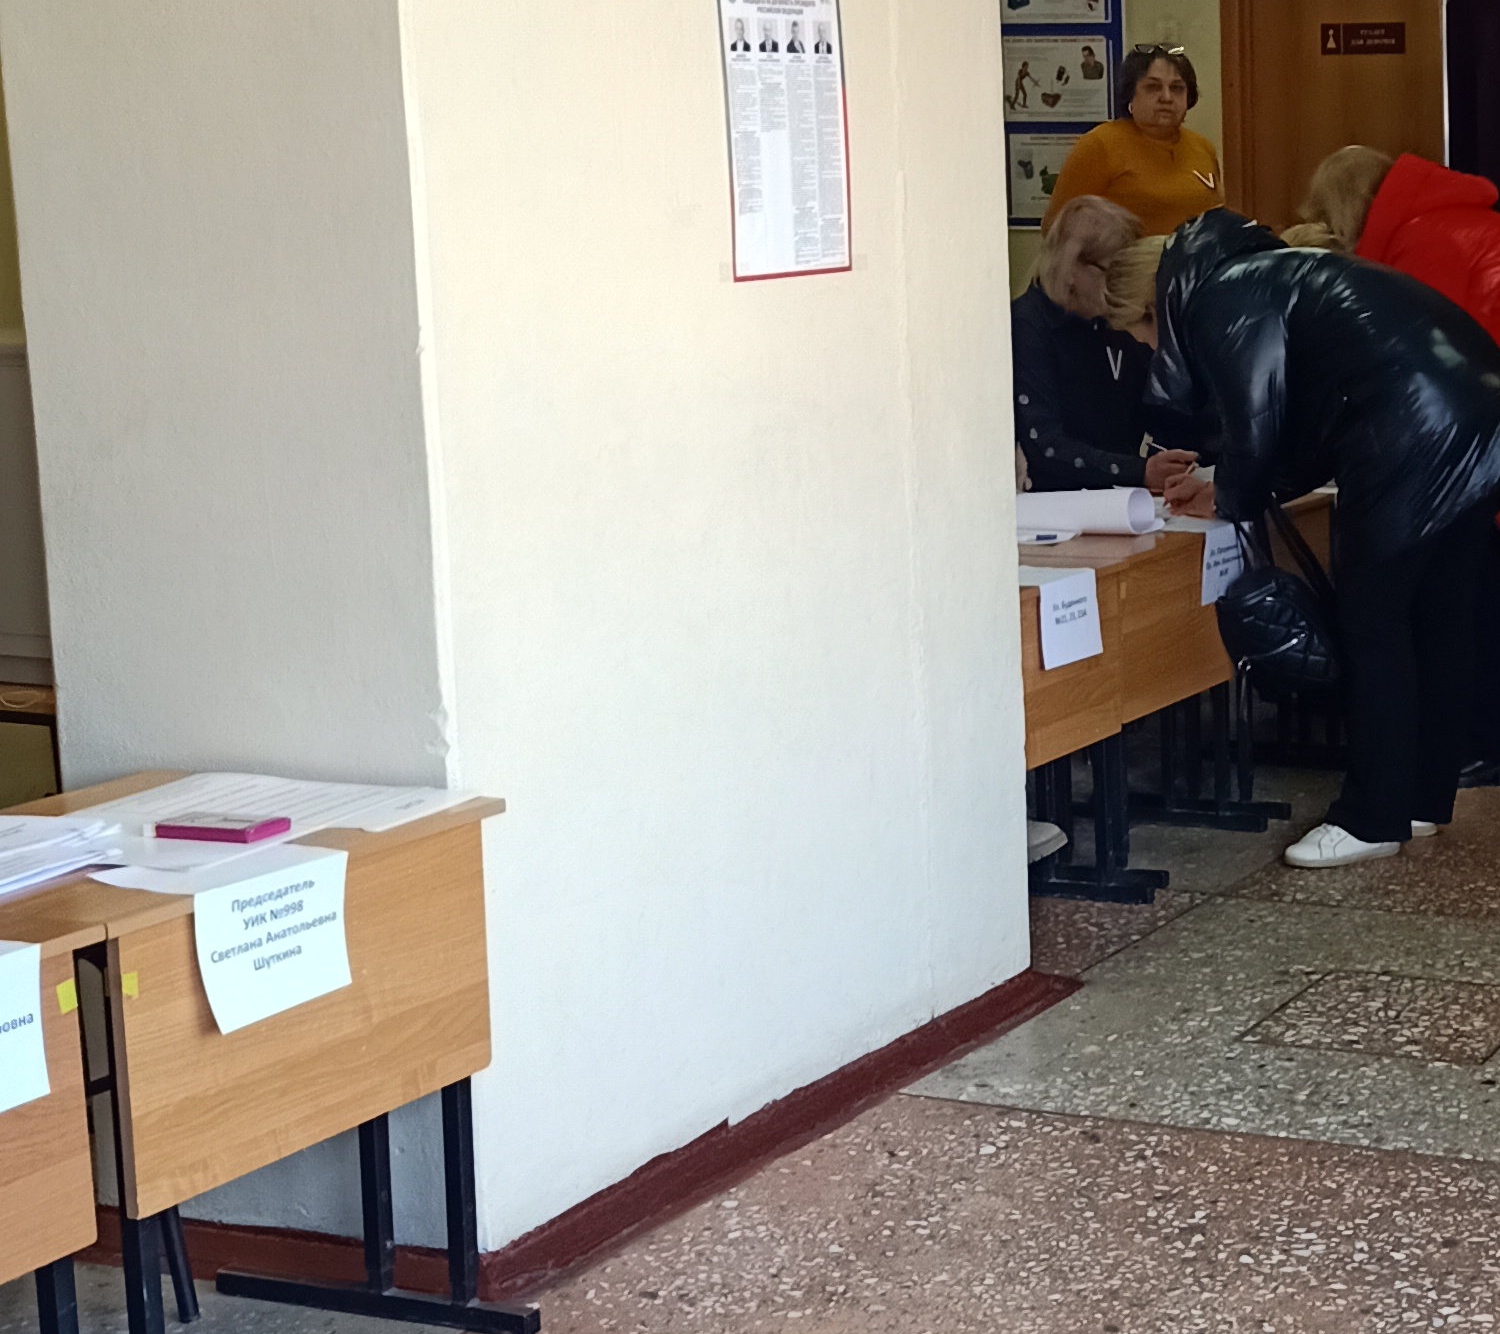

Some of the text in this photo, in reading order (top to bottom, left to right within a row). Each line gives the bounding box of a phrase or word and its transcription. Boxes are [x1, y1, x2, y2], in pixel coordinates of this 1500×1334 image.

[231, 879, 315, 913] Председатель
[243, 899, 304, 930] УИК №998
[210, 911, 337, 964] Светлана Анатольевна
